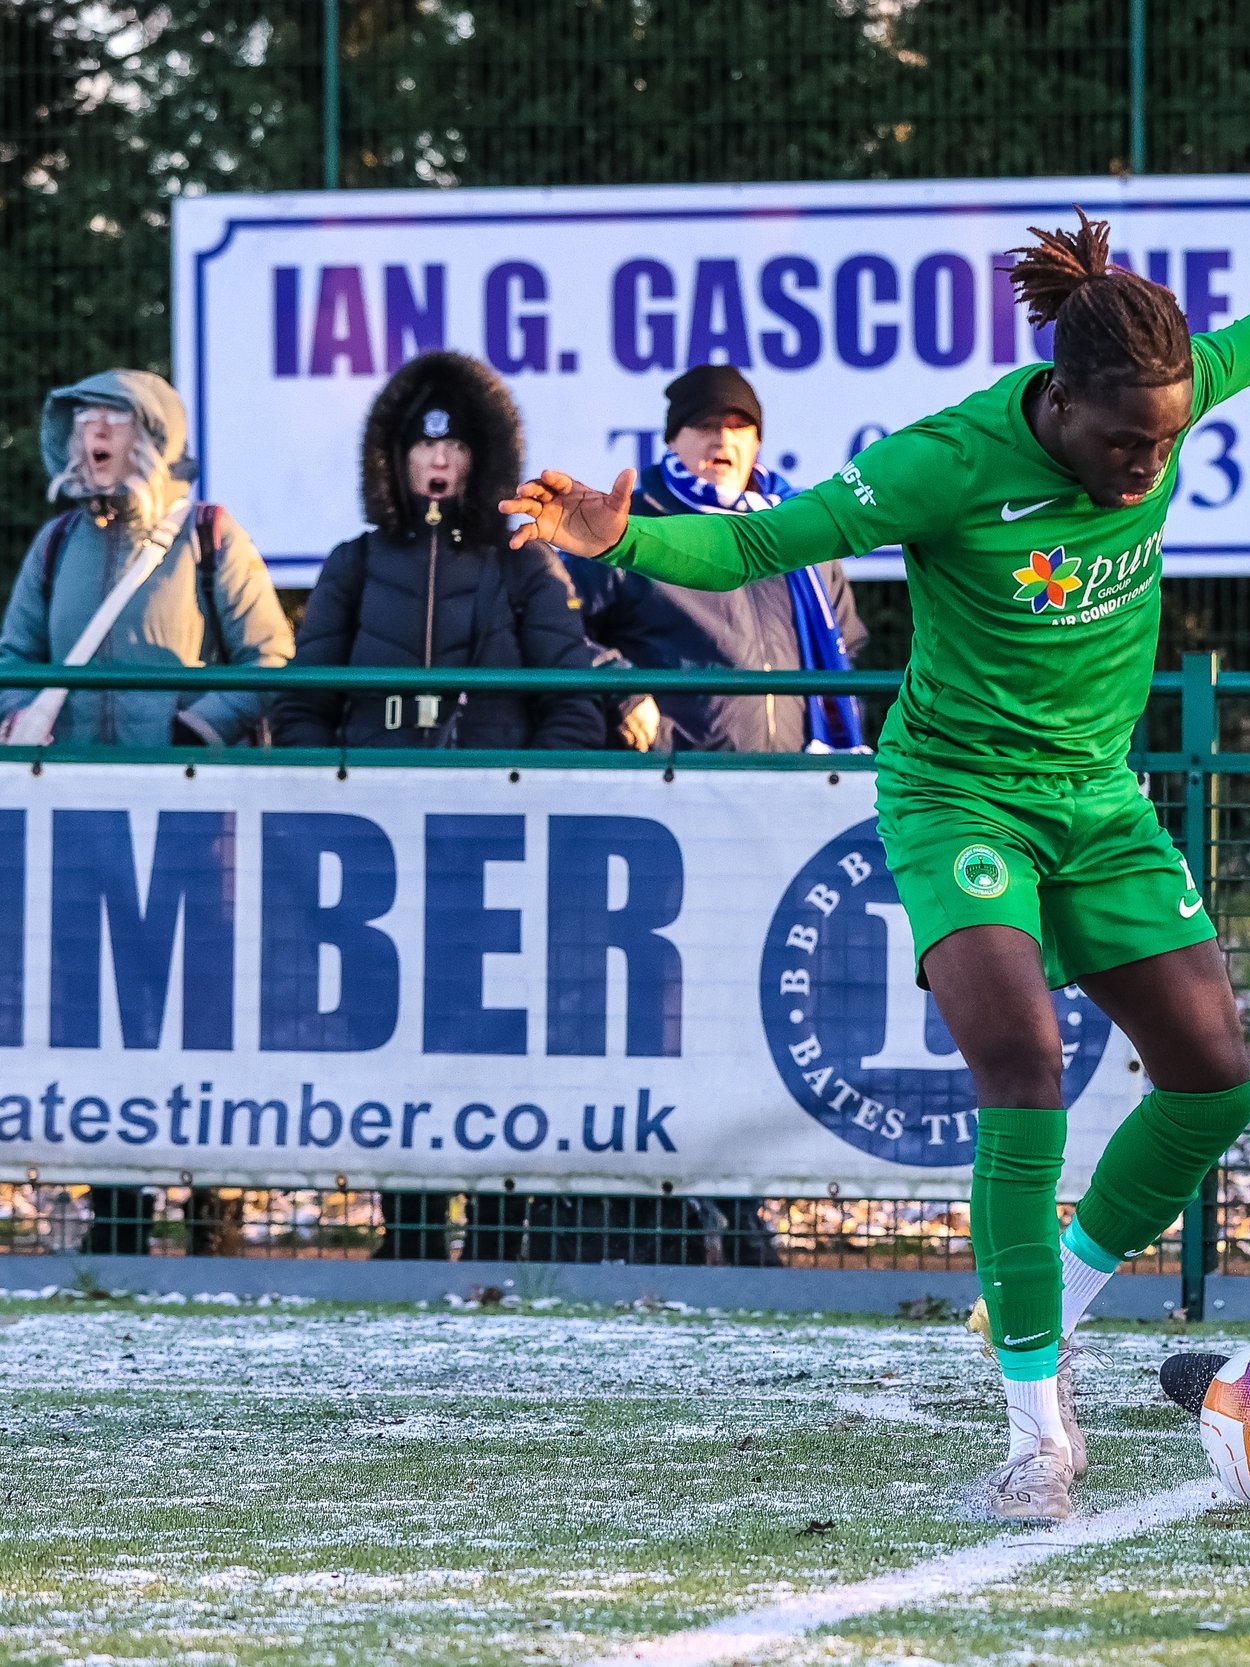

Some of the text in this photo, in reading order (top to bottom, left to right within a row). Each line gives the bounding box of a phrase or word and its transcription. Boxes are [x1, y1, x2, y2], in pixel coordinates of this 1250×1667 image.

[274, 261, 446, 378] IAN
[484, 259, 578, 376] G.
[611, 248, 1232, 375] GASCOIE
[1097, 578, 1132, 599] GROUP
[0, 1080, 678, 1153] atestimber.co.uk
[788, 1033, 906, 1140] BATES
